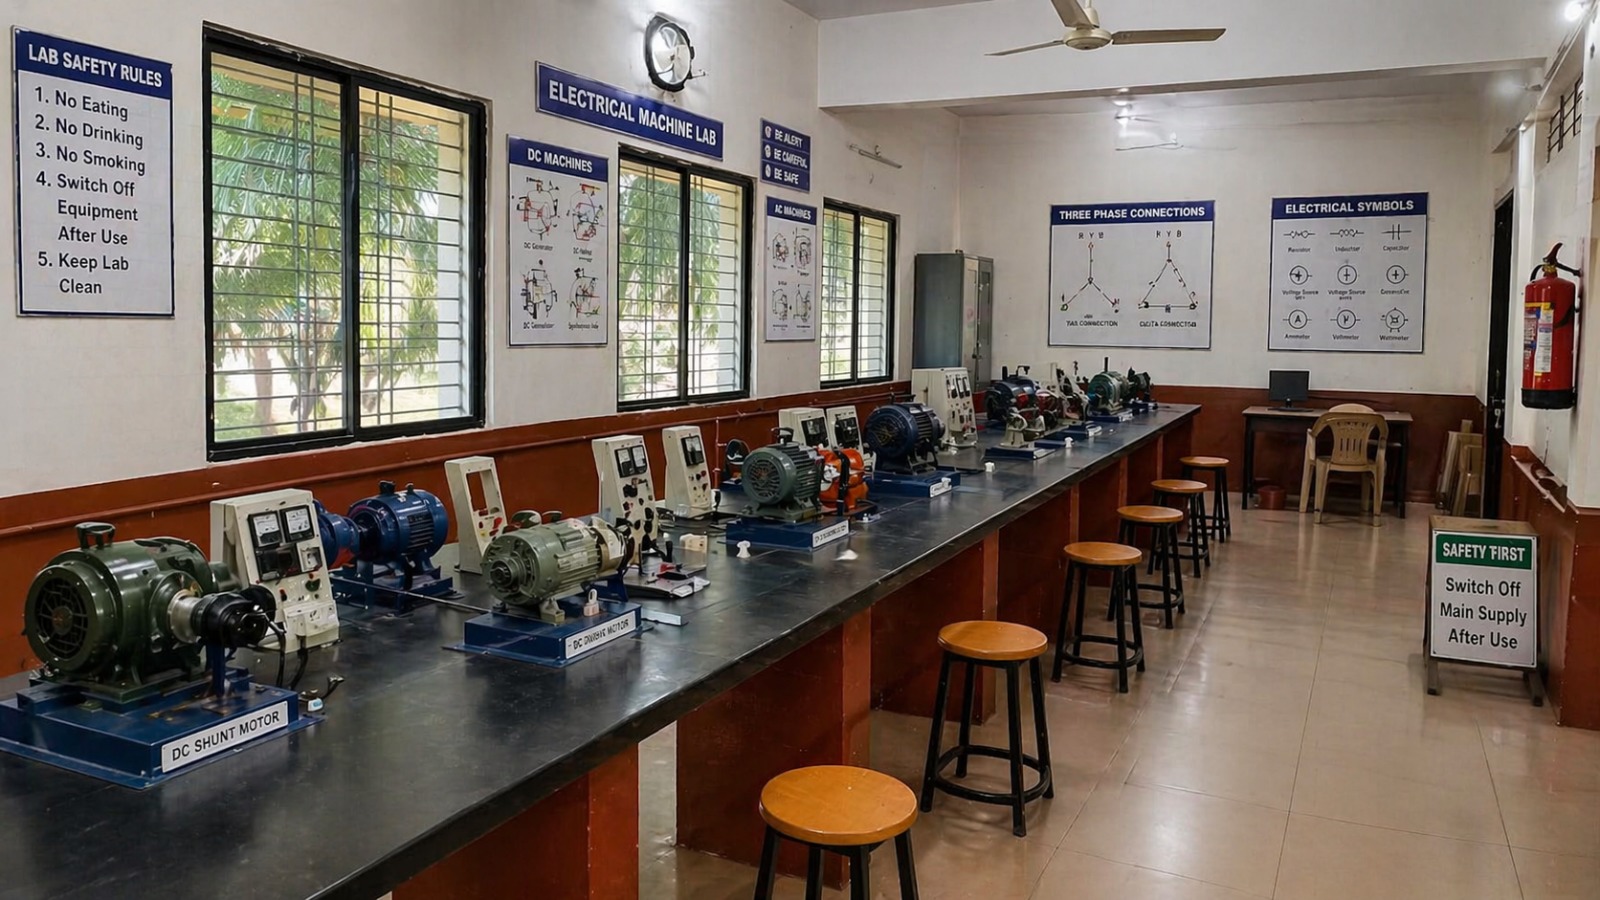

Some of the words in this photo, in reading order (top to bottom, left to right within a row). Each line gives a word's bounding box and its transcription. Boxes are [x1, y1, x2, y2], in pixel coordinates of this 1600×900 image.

[28, 44, 59, 65] LAB
[62, 52, 117, 78] SAFETY
[120, 64, 162, 88] RULES
[35, 86, 49, 104] 1.
[55, 90, 77, 108] No
[82, 95, 128, 122] Eating
[549, 79, 635, 122] ELECTRICAL
[638, 106, 693, 140] MACHINE
[696, 125, 717, 146] LAB
[35, 114, 50, 131] 2.
[56, 118, 77, 135] No
[82, 122, 143, 150] Drinking
[36, 142, 51, 159] 3.
[57, 145, 78, 163] No
[83, 150, 145, 176] Smoking
[527, 147, 542, 163] DC
[543, 151, 593, 173] MACHINES
[36, 171, 51, 187] 4.
[57, 173, 108, 193] Switch
[113, 180, 135, 197] Off
[58, 199, 138, 221] Equipment
[775, 204, 783, 214] AC
[1059, 210, 1091, 220] THREE
[1093, 208, 1127, 219] PHASE
[1130, 207, 1205, 218] CONNECTIONS
[1285, 202, 1354, 214] ELECTRICAL
[1357, 200, 1414, 212] SYMBOLS
[58, 226, 96, 243] After
[101, 229, 128, 245] Use
[38, 251, 53, 267] 5.
[59, 252, 98, 272] Keep
[102, 255, 129, 270] Lab
[59, 278, 102, 294] Clean
[1443, 542, 1486, 559] SAFETY
[1489, 545, 1525, 562] FIRST
[1446, 577, 1493, 595] Switch
[1498, 581, 1521, 597] Off
[1440, 602, 1473, 619] Main
[1478, 605, 1527, 627] Supply
[1448, 628, 1485, 645] After
[1490, 631, 1518, 649] Use
[172, 744, 190, 761] DC
[194, 726, 236, 753] SHUNT
[239, 710, 280, 736] MOTOR
